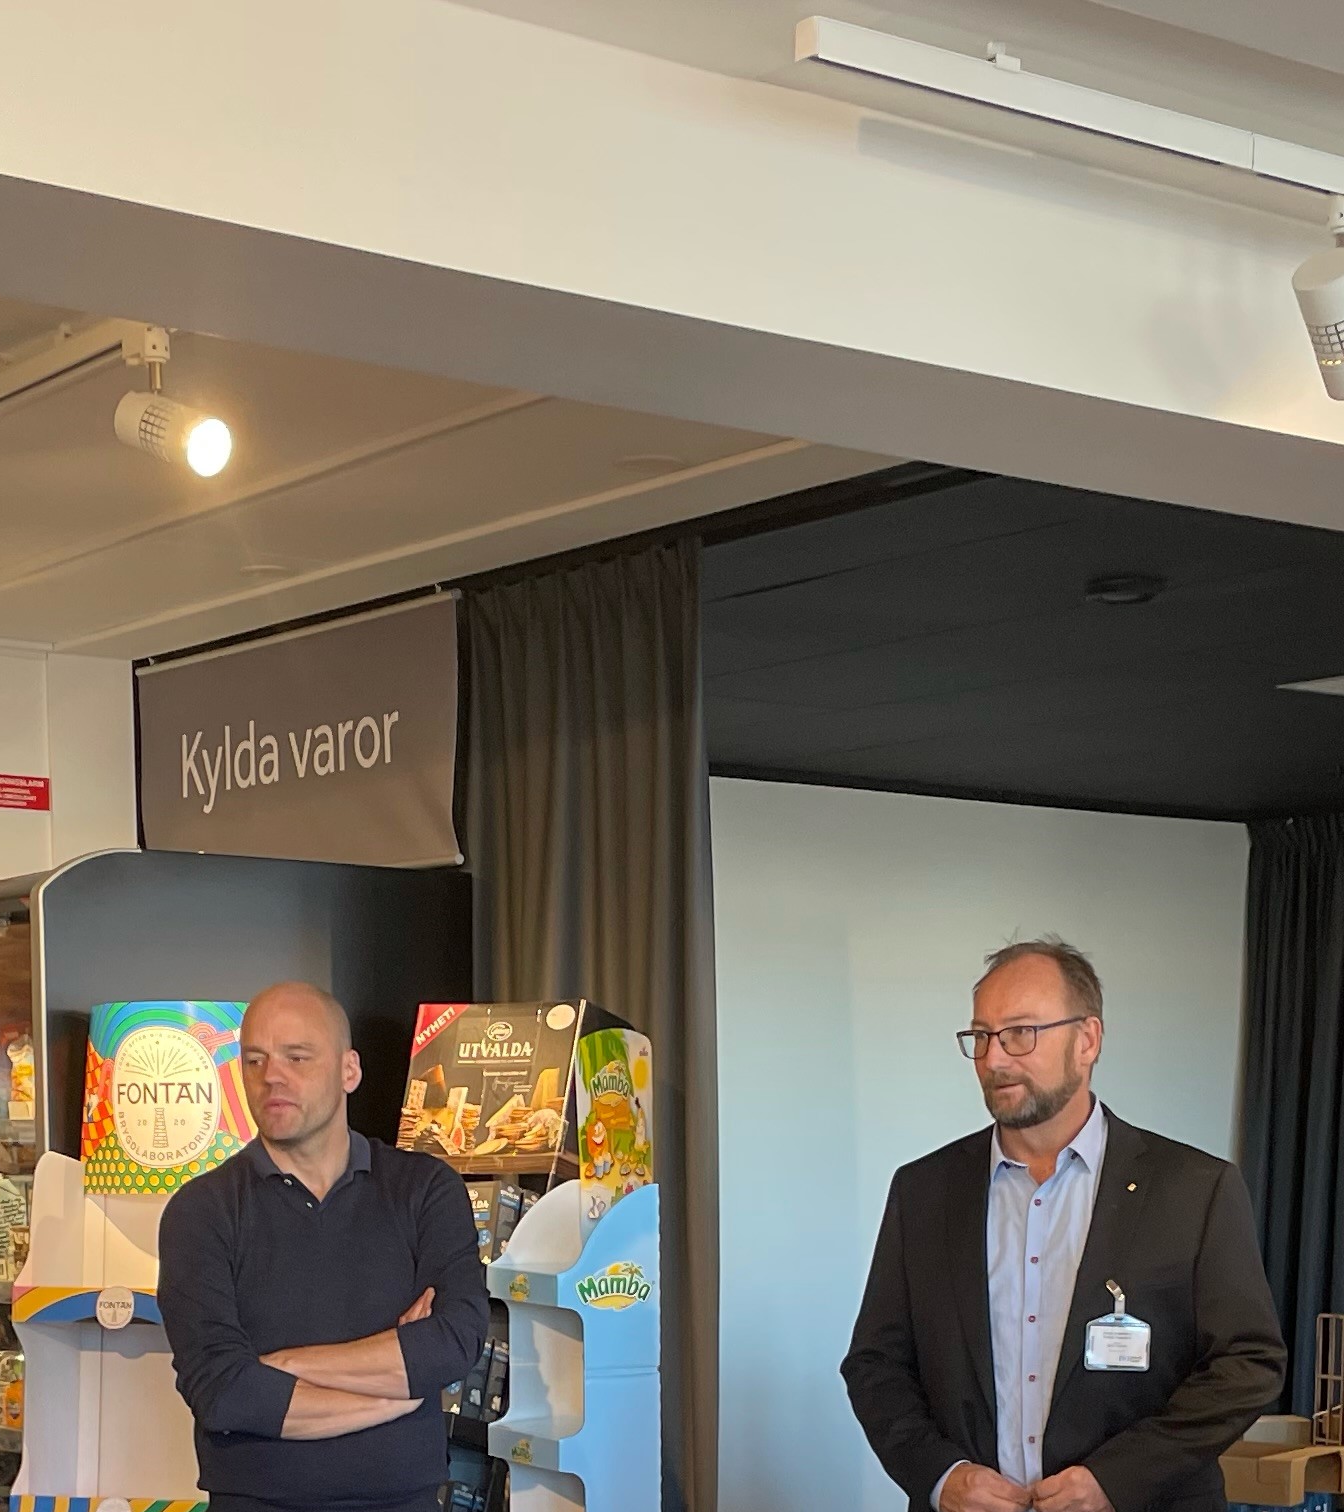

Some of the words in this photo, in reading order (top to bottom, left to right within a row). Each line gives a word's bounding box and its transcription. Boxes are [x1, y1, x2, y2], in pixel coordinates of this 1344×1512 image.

[181, 720, 279, 814] Kylda
[288, 709, 399, 779] varor
[414, 1006, 456, 1046] NYHET!
[458, 1037, 534, 1059] UTVALDA
[592, 1073, 629, 1098] Mamba
[577, 1275, 651, 1303] Mamba
